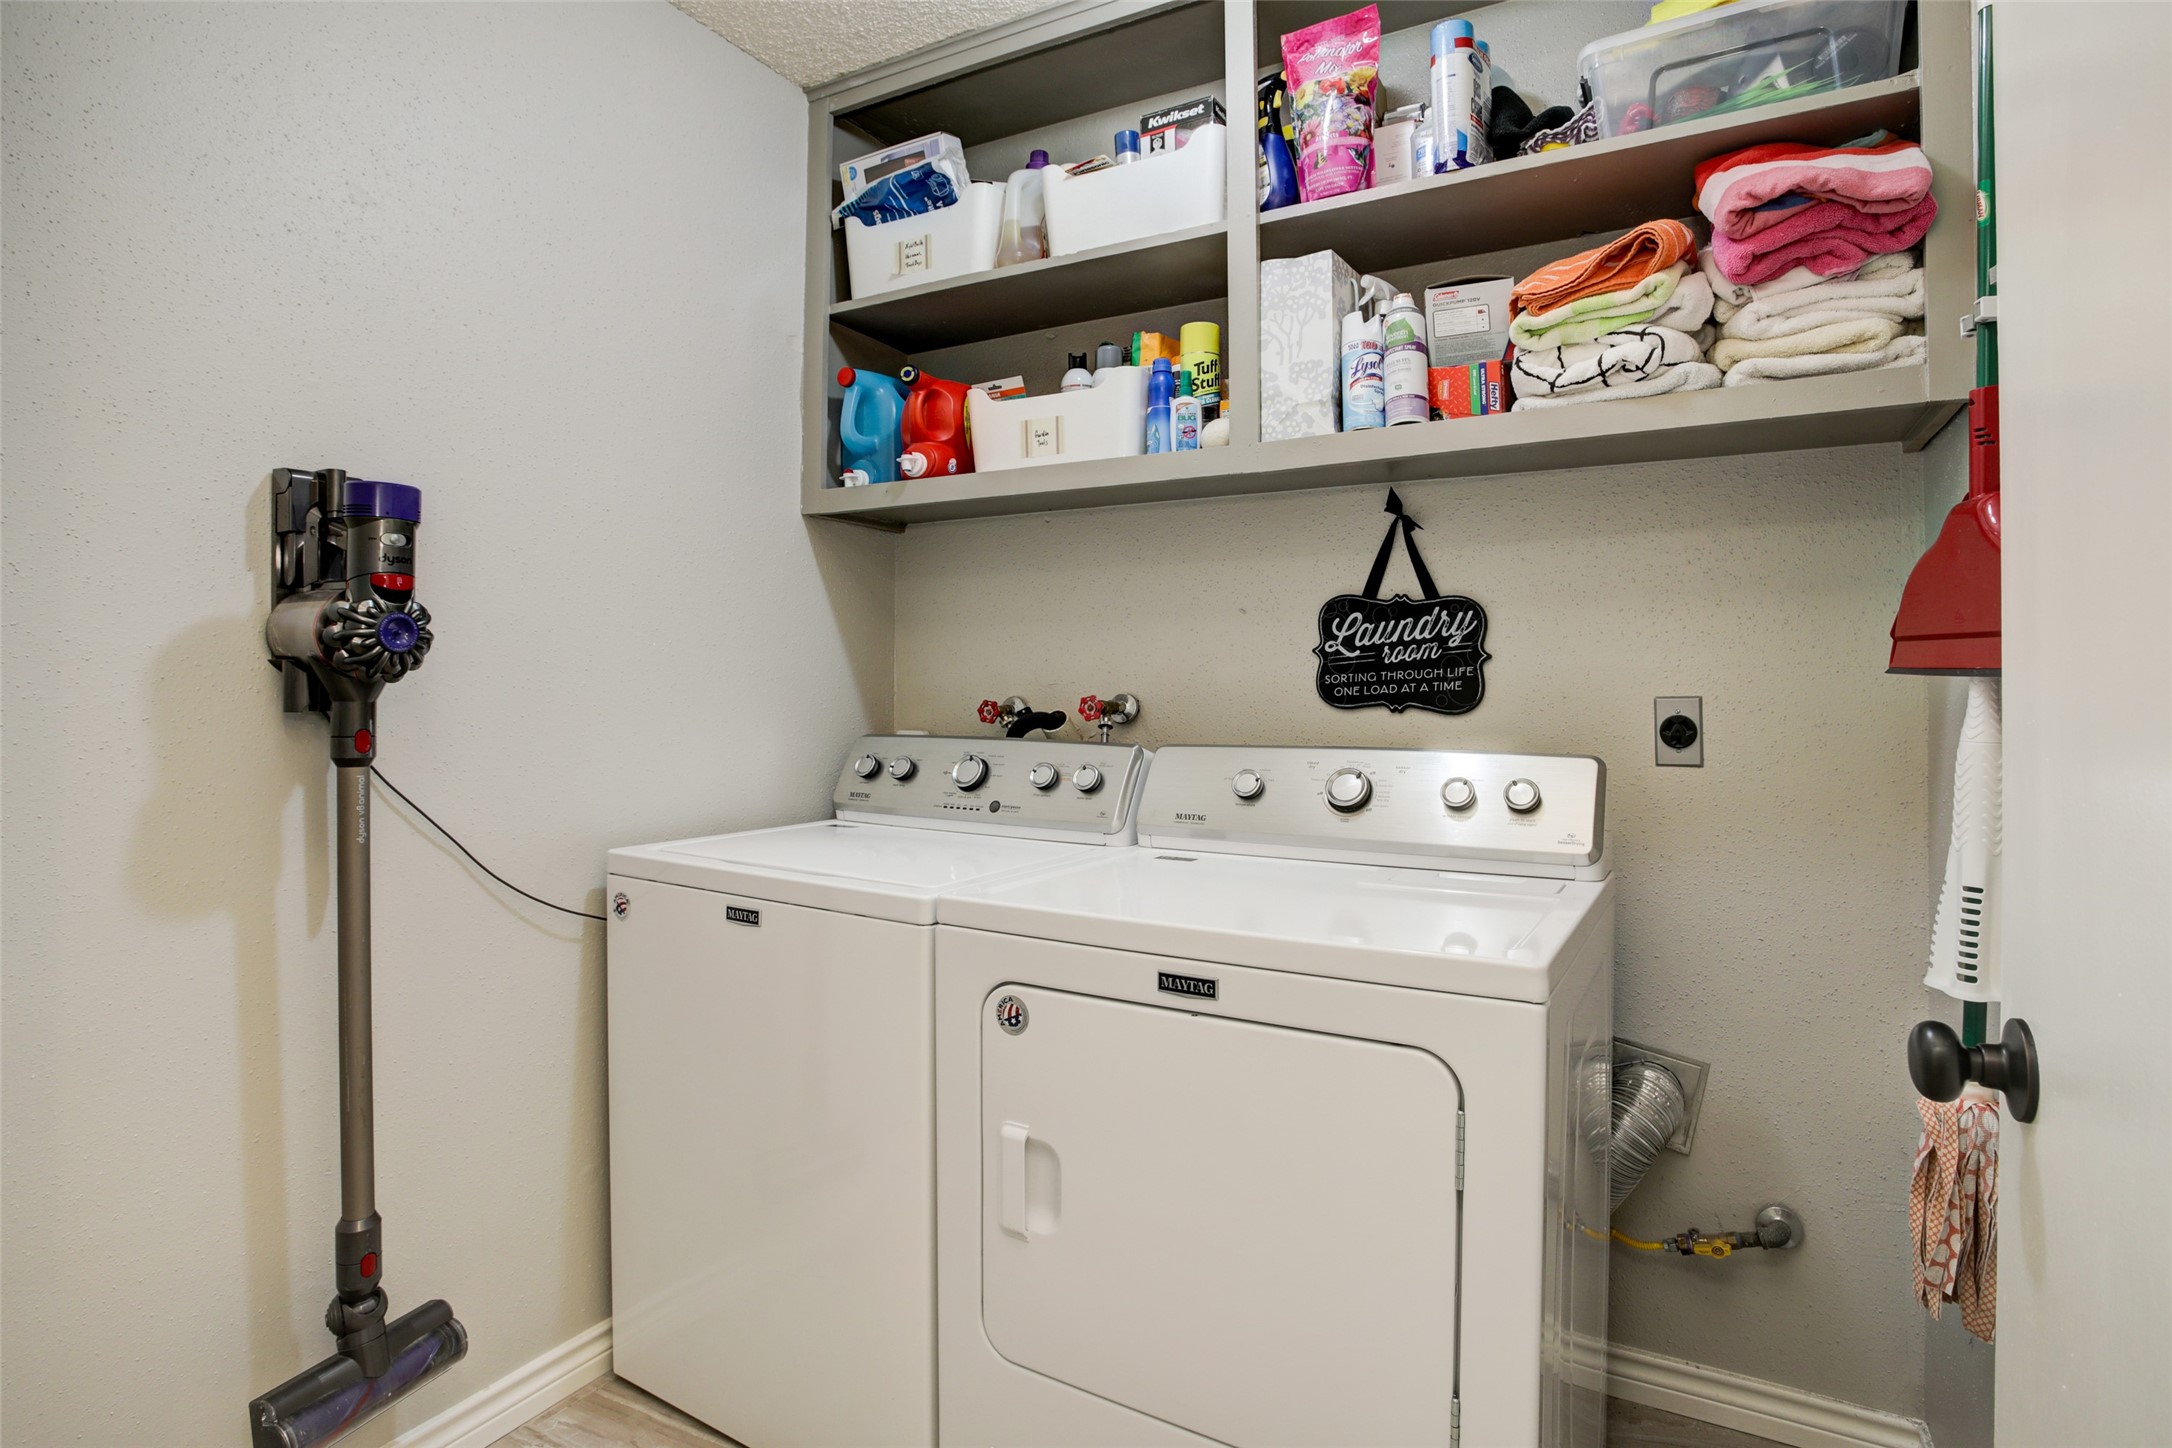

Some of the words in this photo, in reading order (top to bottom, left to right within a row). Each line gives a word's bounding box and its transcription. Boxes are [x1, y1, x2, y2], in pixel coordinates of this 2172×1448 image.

[1315, 61, 1342, 75] Mix
[1148, 103, 1205, 129] Kwikset
[1194, 359, 1219, 376] Tuff
[1350, 356, 1384, 379] Lysol
[1192, 374, 1220, 392] Stuff
[1490, 383, 1499, 410] Hefty
[378, 553, 412, 566] dyson
[1325, 606, 1478, 657] Laundry
[1382, 641, 1443, 664] room
[1325, 672, 1377, 684] SORTING
[1380, 668, 1443, 681] THROUGH
[1447, 666, 1475, 677] LIFE
[1334, 684, 1360, 697] ONE
[1364, 684, 1398, 695] LOAD
[1400, 683, 1417, 693] AT
[1420, 683, 1429, 692] A
[1432, 680, 1463, 691] TIME
[849, 791, 871, 799] MAYTAG
[1175, 813, 1207, 821] MAYTAG
[356, 817, 367, 844] dyson
[727, 908, 758, 923] MAYTAG
[1160, 976, 1215, 995] MAYTAG
[997, 996, 1013, 1026] AMERICA
